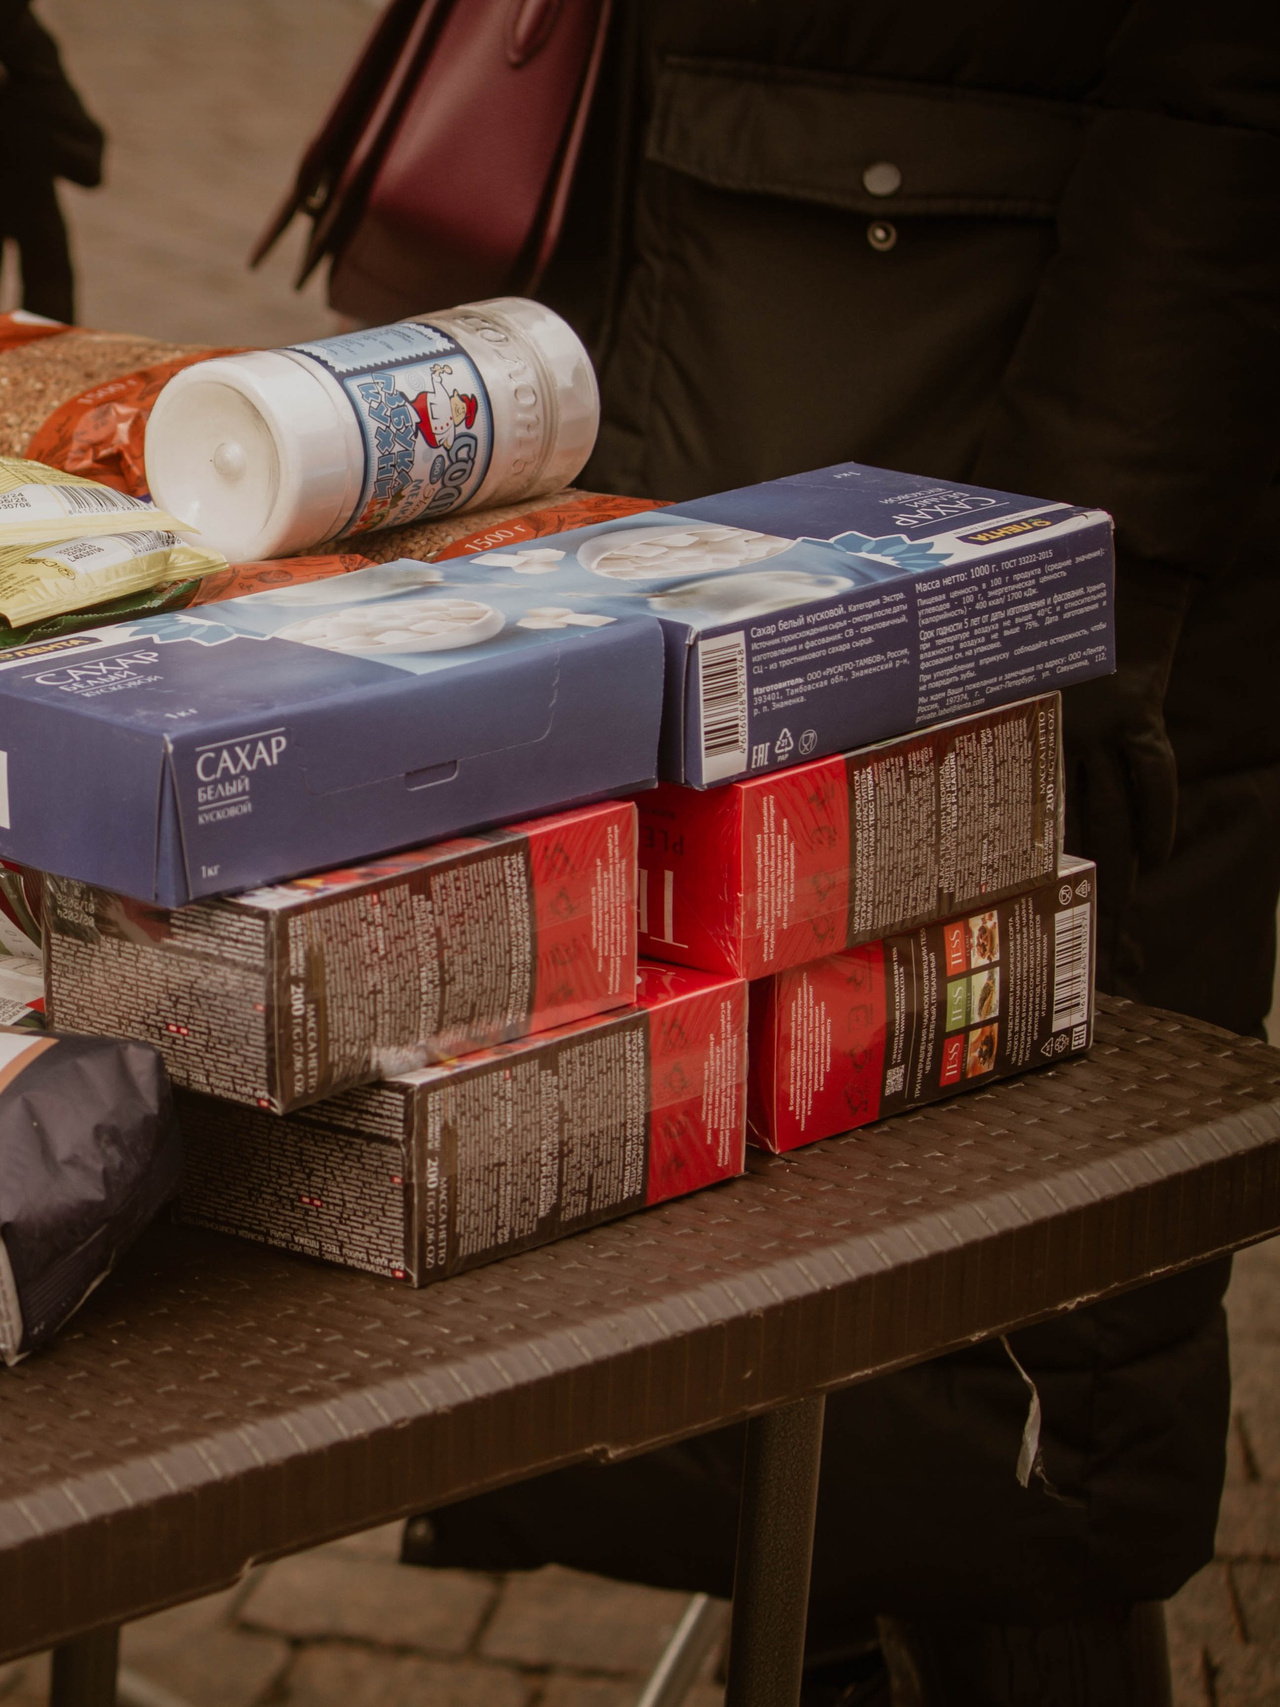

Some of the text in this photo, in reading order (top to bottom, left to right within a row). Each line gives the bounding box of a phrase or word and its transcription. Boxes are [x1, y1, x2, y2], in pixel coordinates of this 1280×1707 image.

[357, 382, 398, 500] КУХНИ
[371, 371, 417, 496] АЗБУКА
[891, 496, 996, 526] САХАР
[464, 523, 526, 554] 1500 г
[968, 521, 1033, 542] ЛЕНТА
[915, 577, 940, 594] Масса
[942, 571, 967, 586] нетто:
[970, 564, 989, 579] 1000
[1001, 558, 1016, 570] ГОСТ
[1018, 548, 1053, 566] 33222-2015
[750, 590, 905, 639] Сахар белый кусковой. Категория Экстра.
[10, 637, 89, 659] ЛЕНТА
[34, 650, 160, 687] САХАР
[59, 669, 136, 693] БЕЛЫЙ
[80, 673, 164, 698] КУСКОВОЙ
[196, 734, 287, 784] САХАР
[197, 776, 250, 803] БЕЛЫЙ
[1044, 783, 1052, 813] 200
[198, 800, 252, 825] КУСКОВОЙ
[948, 804, 956, 829] TESS
[950, 928, 963, 967] TESS
[292, 983, 305, 1015] 200
[950, 985, 963, 1022] TESS
[307, 1003, 317, 1093] МАССА НЕТТО
[946, 1041, 961, 1080] TESS
[428, 1156, 439, 1188] 200
[438, 1176, 447, 1265] МАССА НЕТТО
[427, 1244, 436, 1268] OZ)
